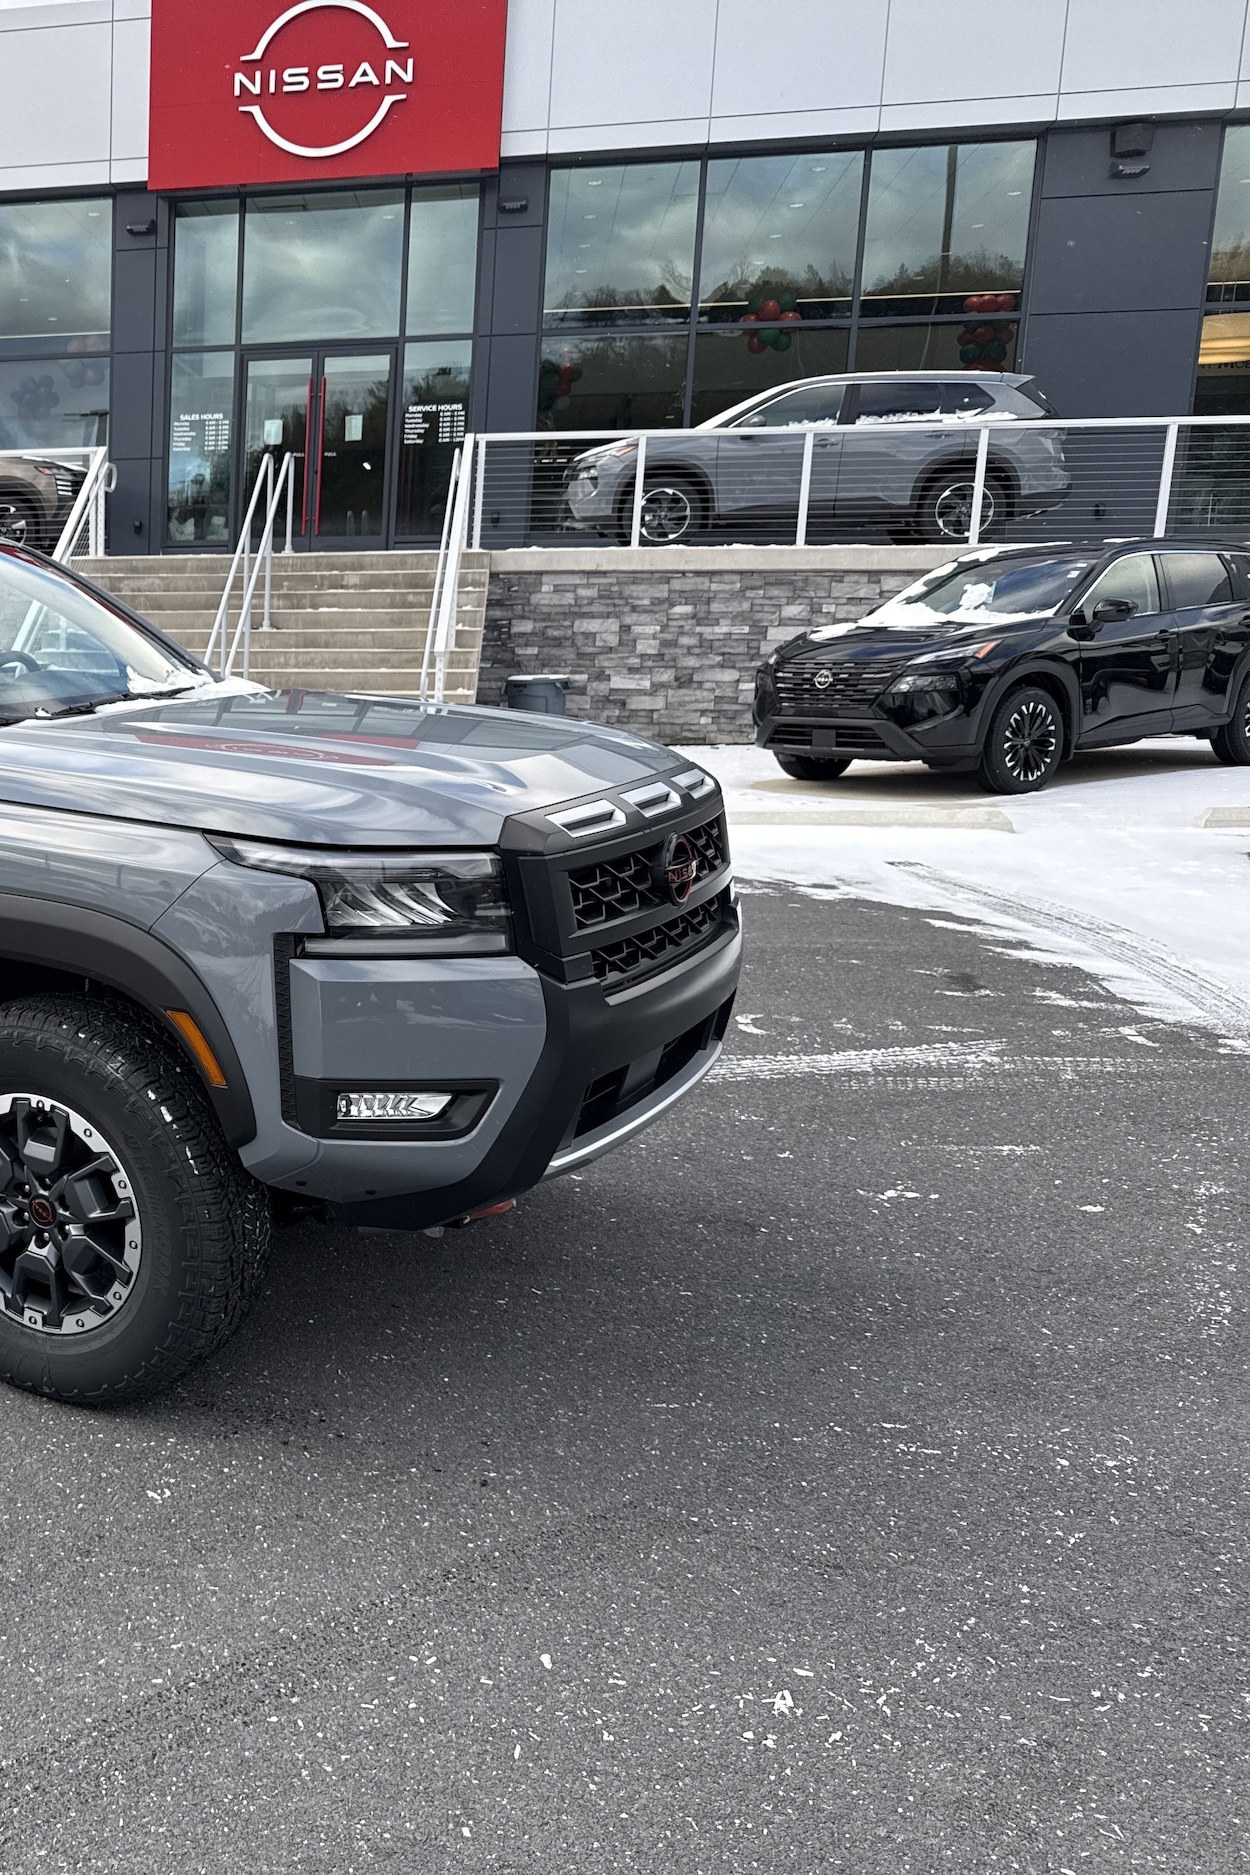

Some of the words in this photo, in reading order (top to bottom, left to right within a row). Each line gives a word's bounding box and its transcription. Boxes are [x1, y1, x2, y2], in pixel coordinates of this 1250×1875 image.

[233, 57, 415, 97] NISSAN
[408, 404, 437, 412] SERVICE
[438, 402, 463, 411] HOURS
[201, 412, 223, 420] HOURS
